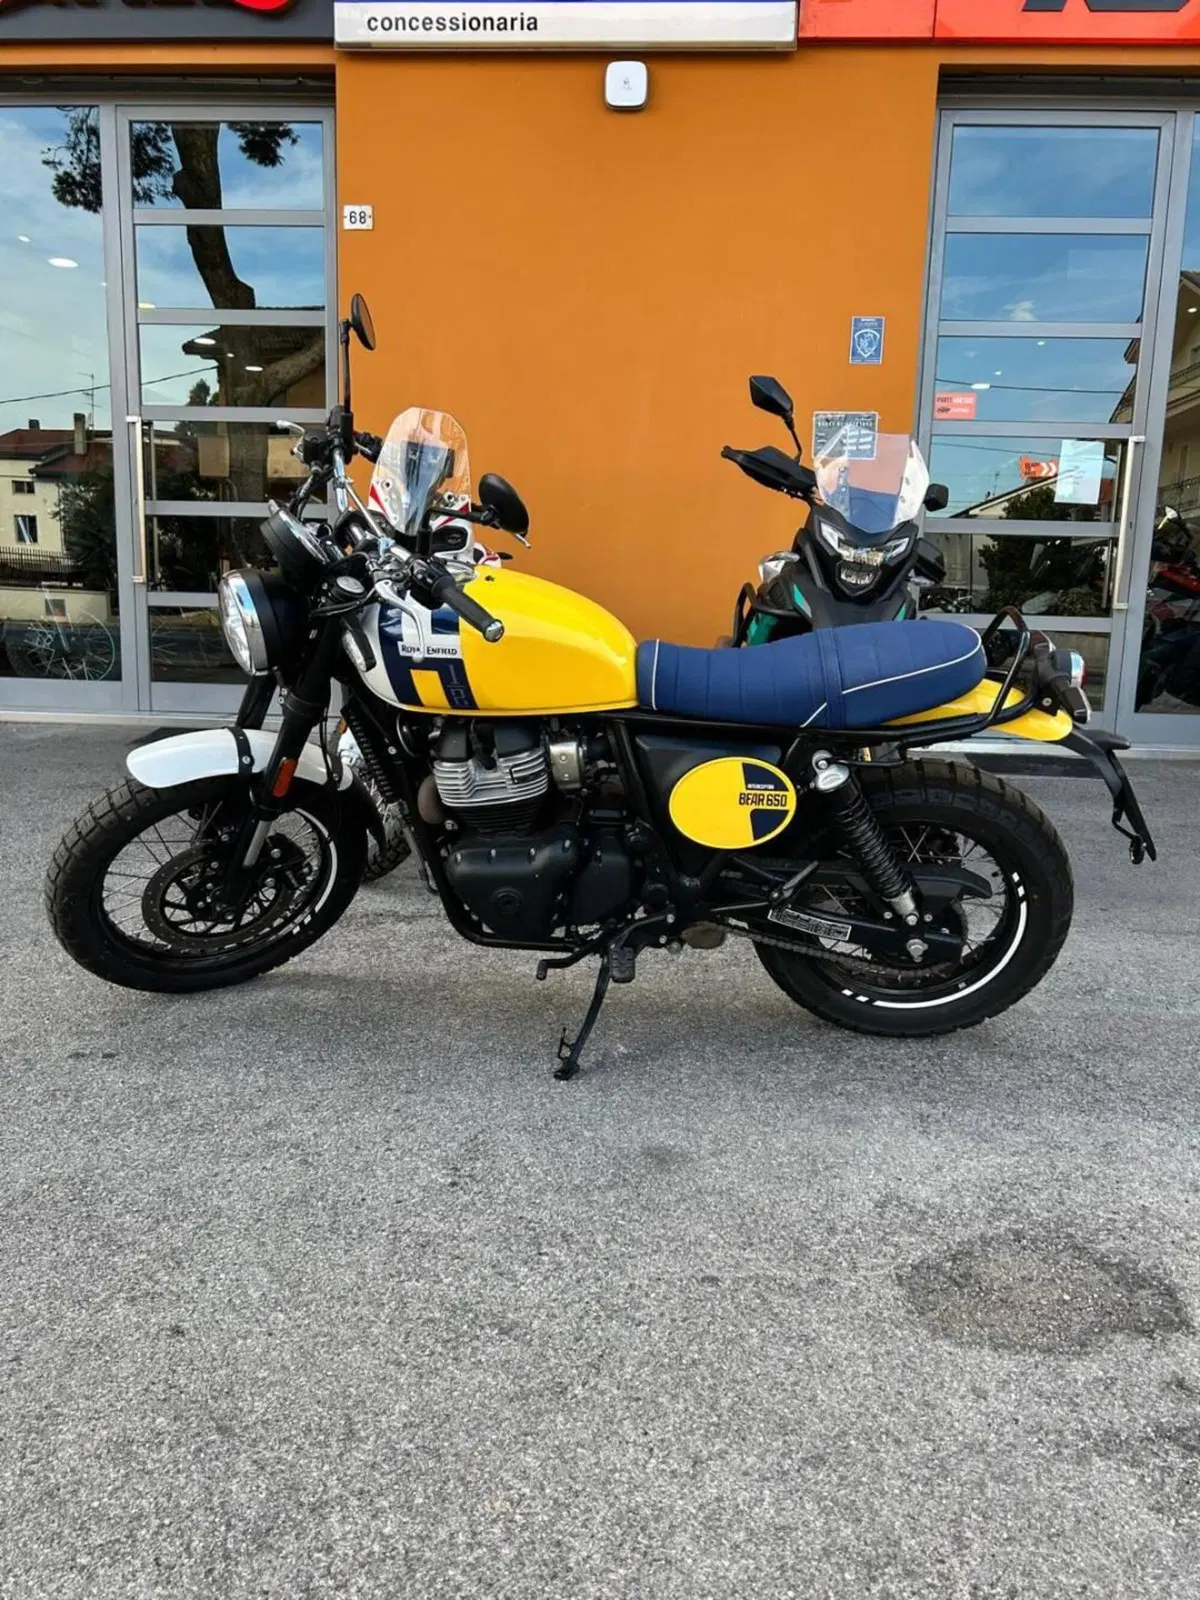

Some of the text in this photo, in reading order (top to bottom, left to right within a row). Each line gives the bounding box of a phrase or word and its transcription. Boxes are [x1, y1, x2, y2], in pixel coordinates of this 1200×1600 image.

[367, 12, 538, 31] concessionaria
[349, 211, 367, 224] 68
[401, 644, 458, 655] ROYA ENFIELD
[738, 793, 787, 807] BEAR 650
